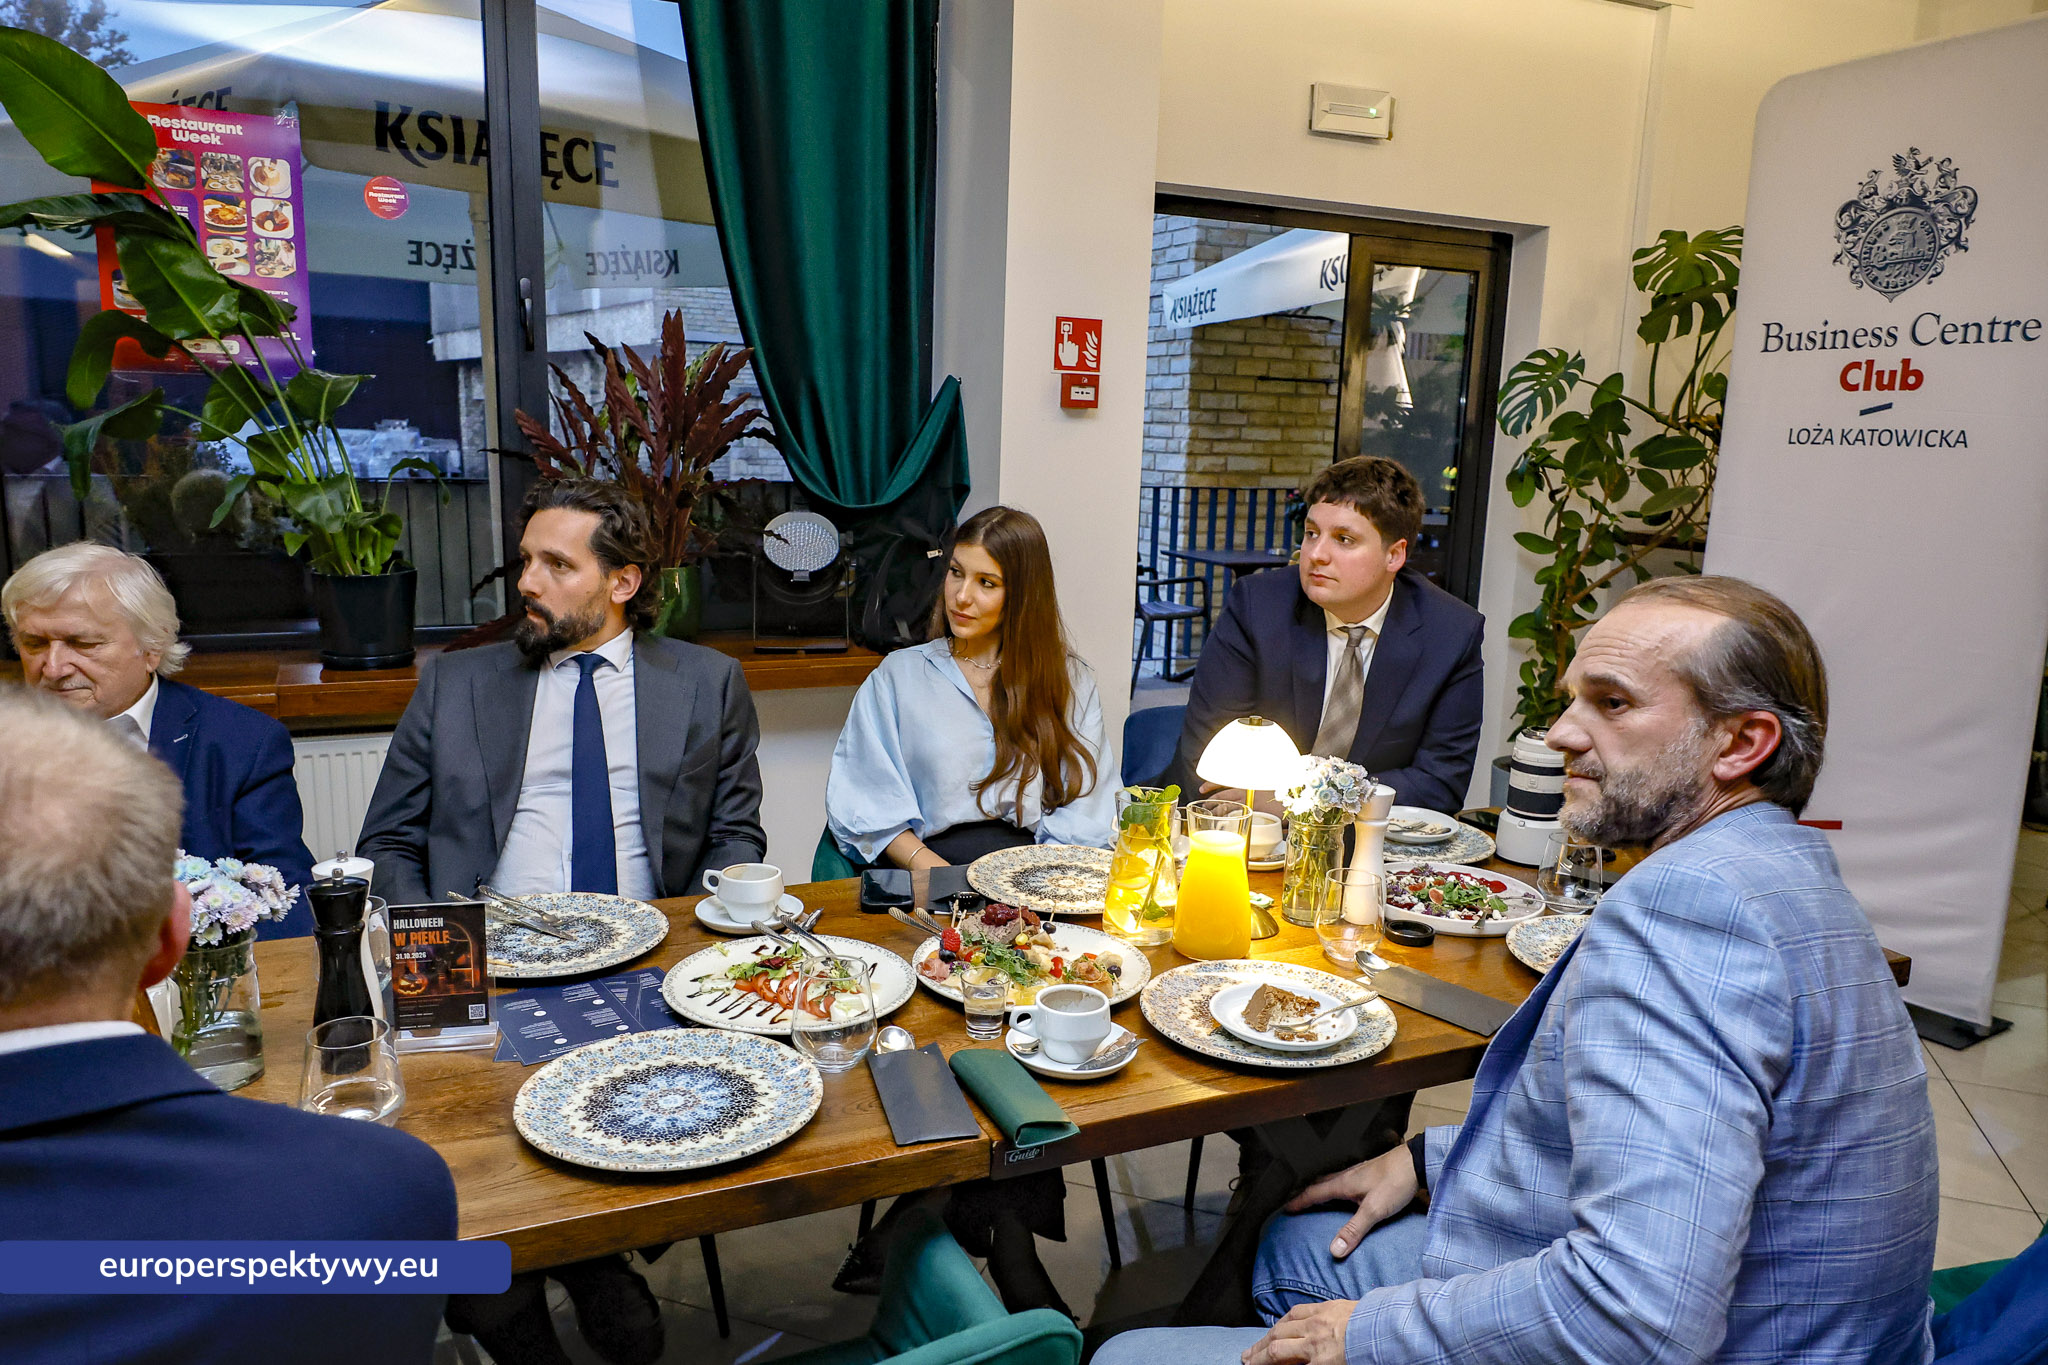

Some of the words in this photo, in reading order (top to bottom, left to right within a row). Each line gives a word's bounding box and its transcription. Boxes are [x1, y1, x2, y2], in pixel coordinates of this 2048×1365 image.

[147, 115, 243, 135] Restaurant
[1170, 287, 1217, 323] KSIĄŻĘCE
[1761, 320, 1898, 352] Business
[1910, 312, 2042, 346] Centre
[1839, 358, 1924, 391] Club
[1788, 423, 1834, 445] LOŻA
[1840, 428, 1968, 448] KATOWICKA
[393, 917, 444, 929] HALLOWEEN
[393, 932, 406, 947] W
[410, 930, 449, 945] PIEKLE
